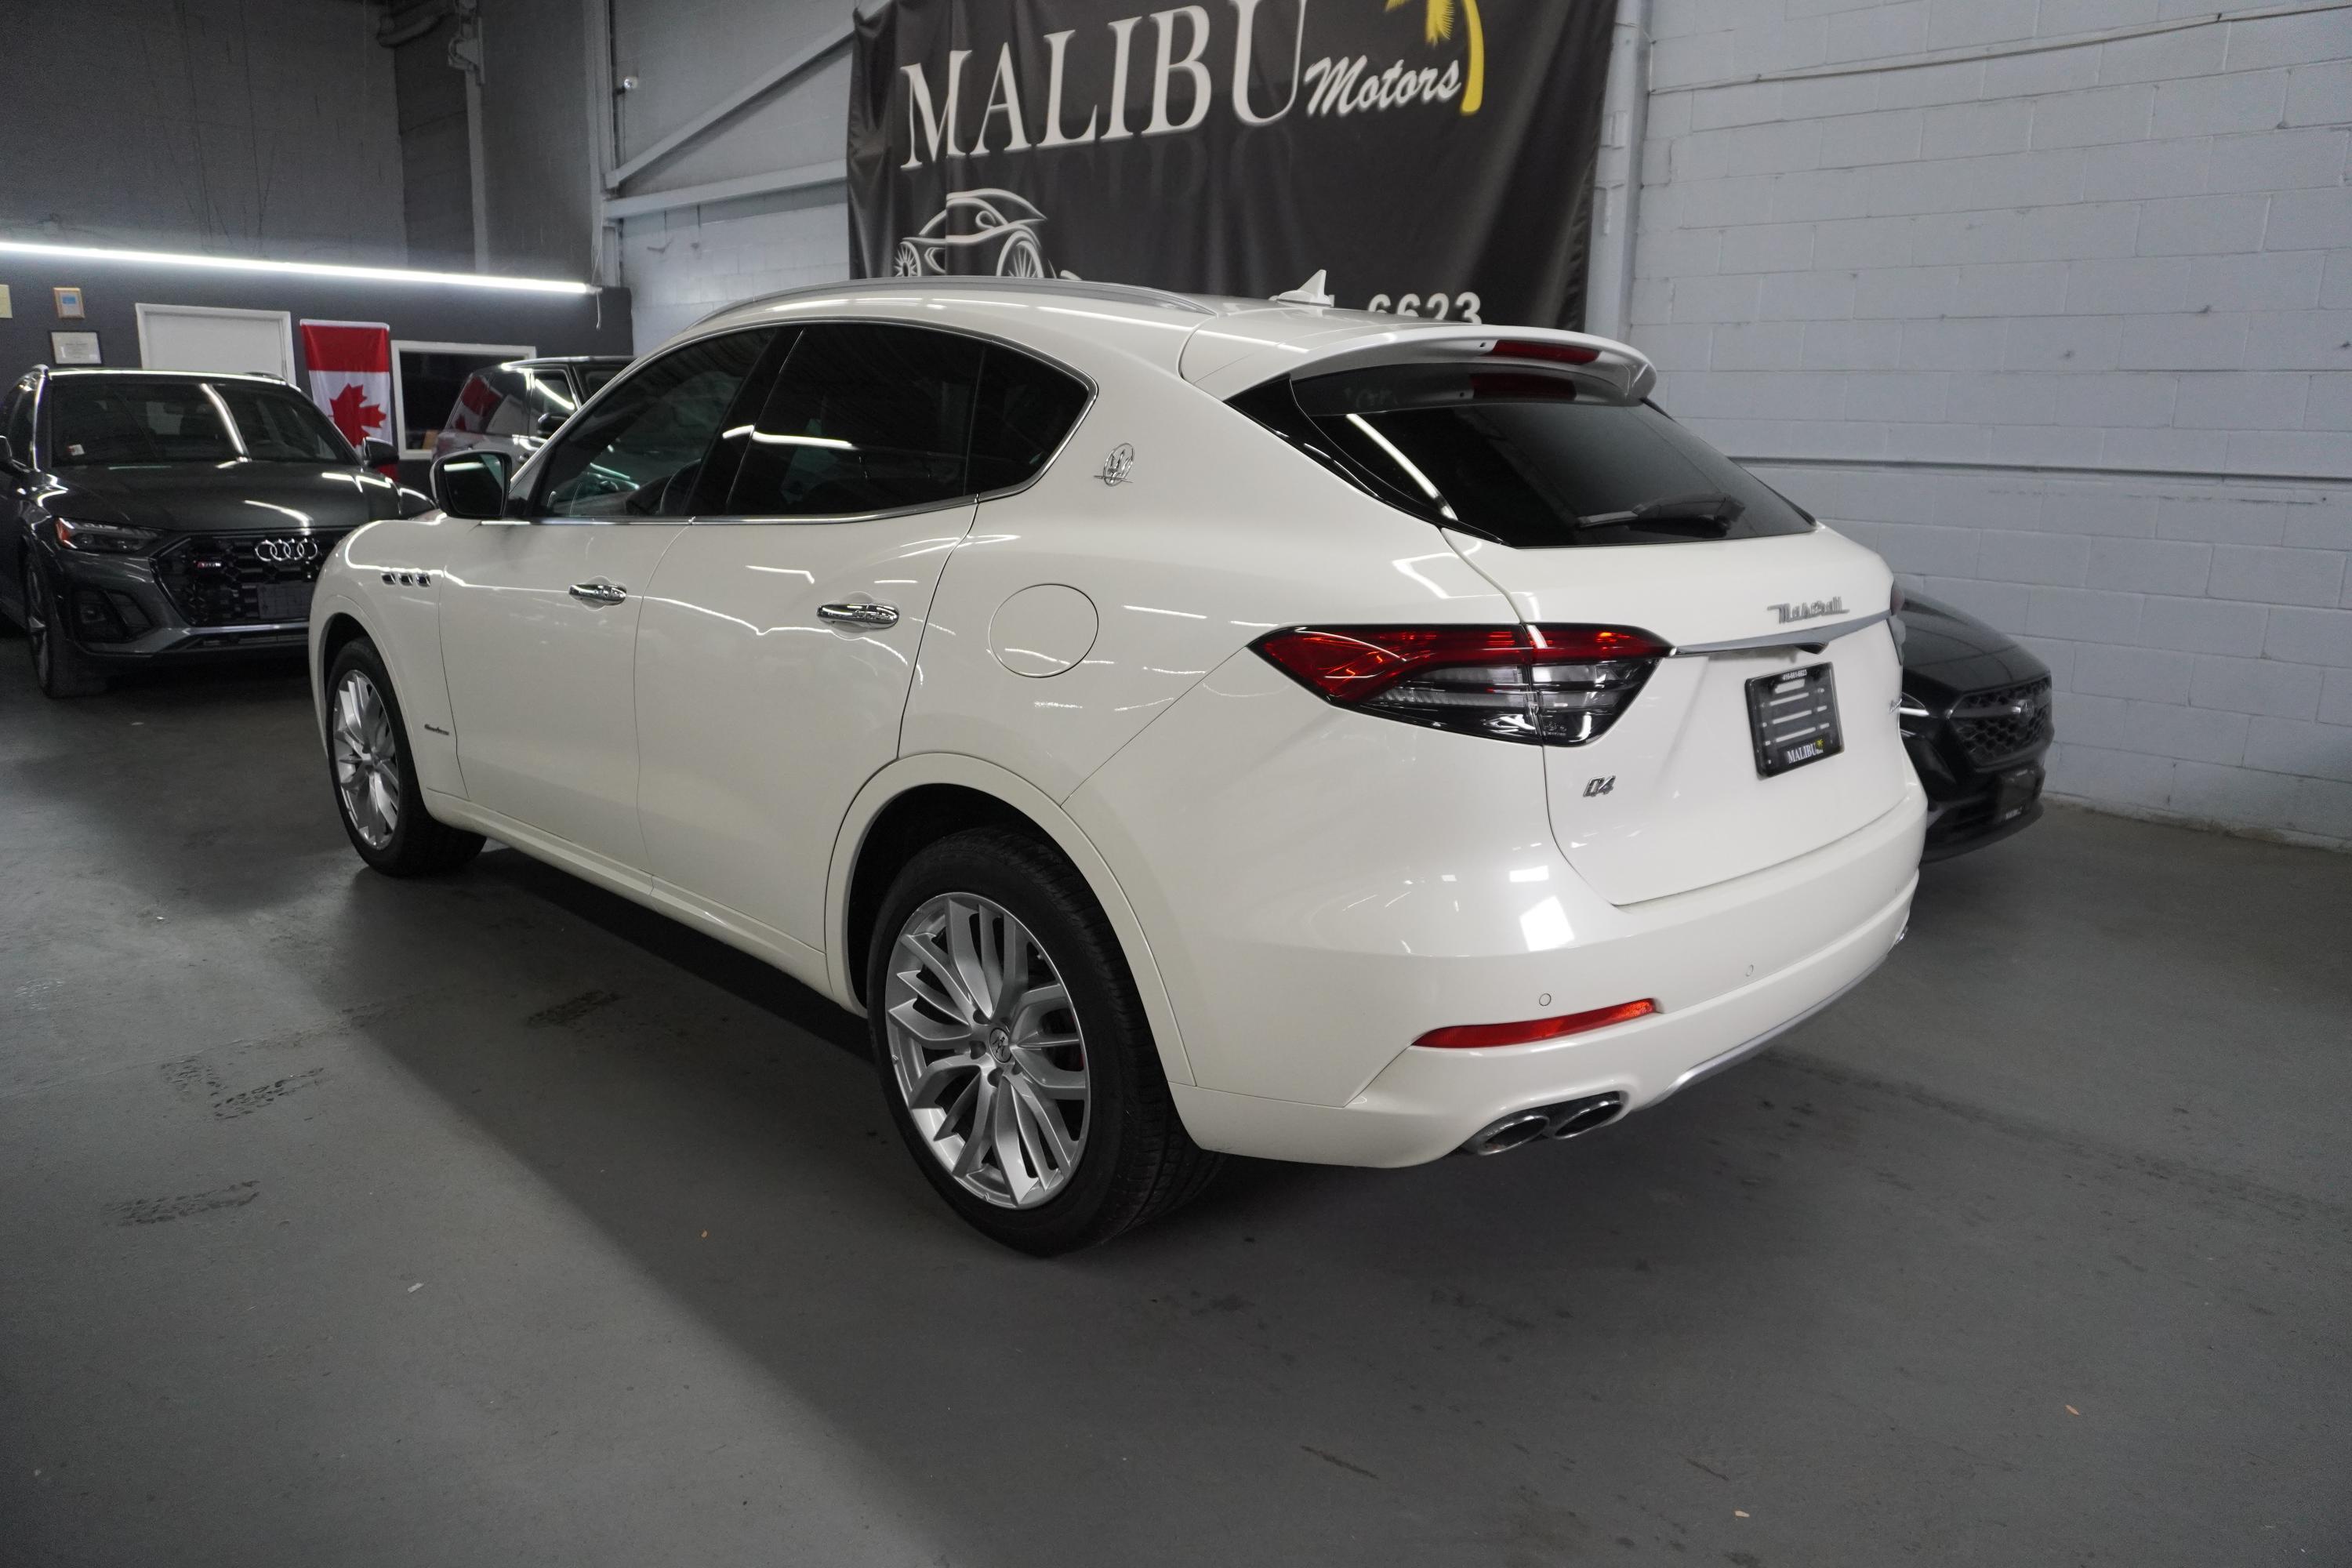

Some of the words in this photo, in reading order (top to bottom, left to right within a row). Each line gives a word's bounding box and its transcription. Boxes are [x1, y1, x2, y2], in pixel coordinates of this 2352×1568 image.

[900, 0, 1308, 170] MALIBU
[1304, 54, 1462, 115] Motors
[1787, 742, 1817, 764] MALIBU
